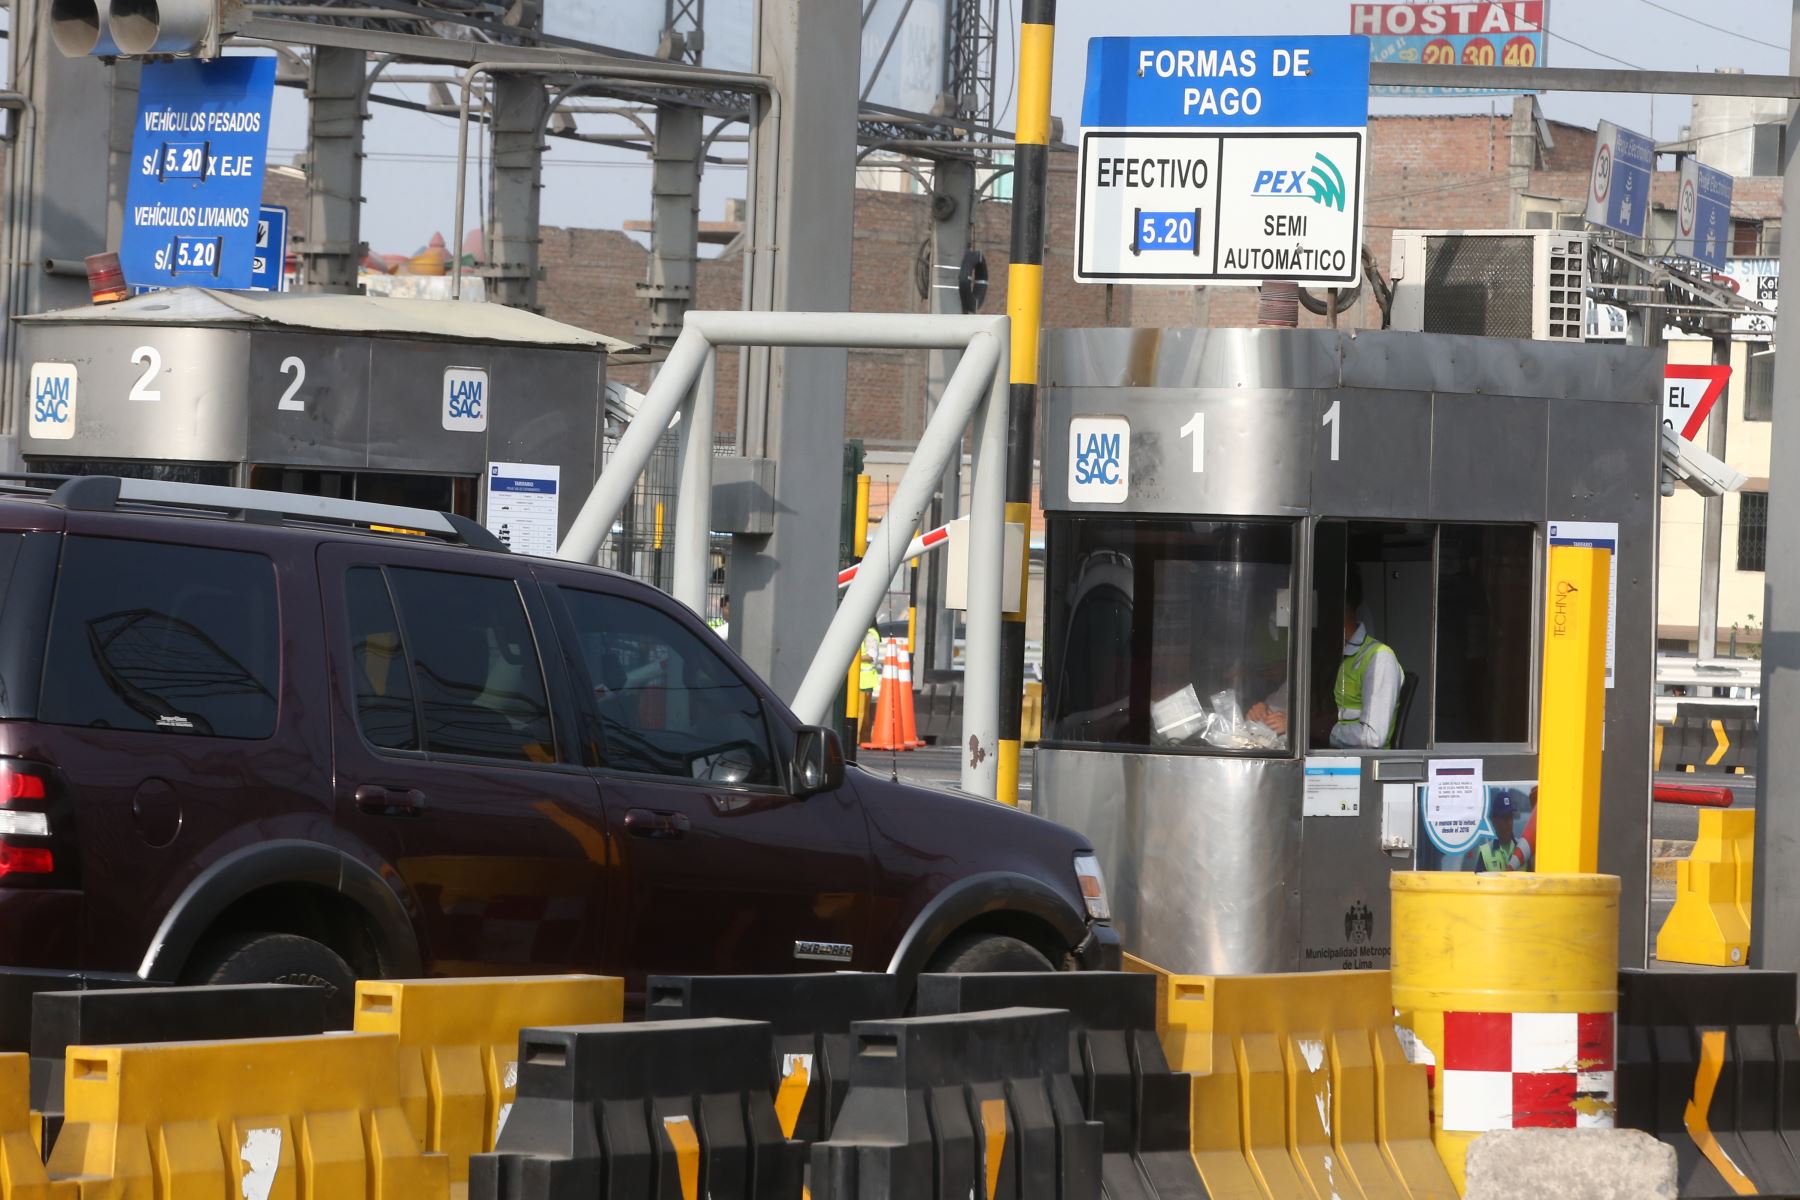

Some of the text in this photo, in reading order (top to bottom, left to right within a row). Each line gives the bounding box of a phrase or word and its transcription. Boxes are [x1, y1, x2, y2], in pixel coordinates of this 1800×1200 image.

[1354, 3, 1538, 34] HOSTAL
[1139, 49, 1310, 78] FORMAS DE
[1427, 45, 1455, 64] 20
[1466, 44, 1494, 66] 30
[1504, 43, 1535, 67] 40
[1183, 88, 1262, 116] PAGO
[145, 107, 261, 132] VEHÍCULOS PESADOS
[220, 156, 253, 176] EJE
[1097, 157, 1208, 189] EFECTIVO
[1598, 155, 1609, 179] 30
[1252, 170, 1306, 193] PEX
[1683, 190, 1692, 213] 30
[134, 202, 249, 227] VEHÍCULOS LIVIANOS
[1263, 215, 1307, 237] SEMI
[1142, 218, 1192, 244] 5.20
[178, 243, 215, 267] 5.20
[1224, 243, 1346, 271] AUTOMÁTICO
[129, 346, 161, 401] 2
[278, 356, 306, 411] 2
[36, 377, 70, 400] LAM
[450, 380, 482, 400] LAM
[1669, 387, 1690, 408] EL
[1180, 412, 1205, 473] 1
[1322, 400, 1341, 461] 1
[1076, 433, 1120, 459] LAM
[1305, 947, 1357, 960] Municipalidad
[1342, 960, 1373, 970] de Lima
